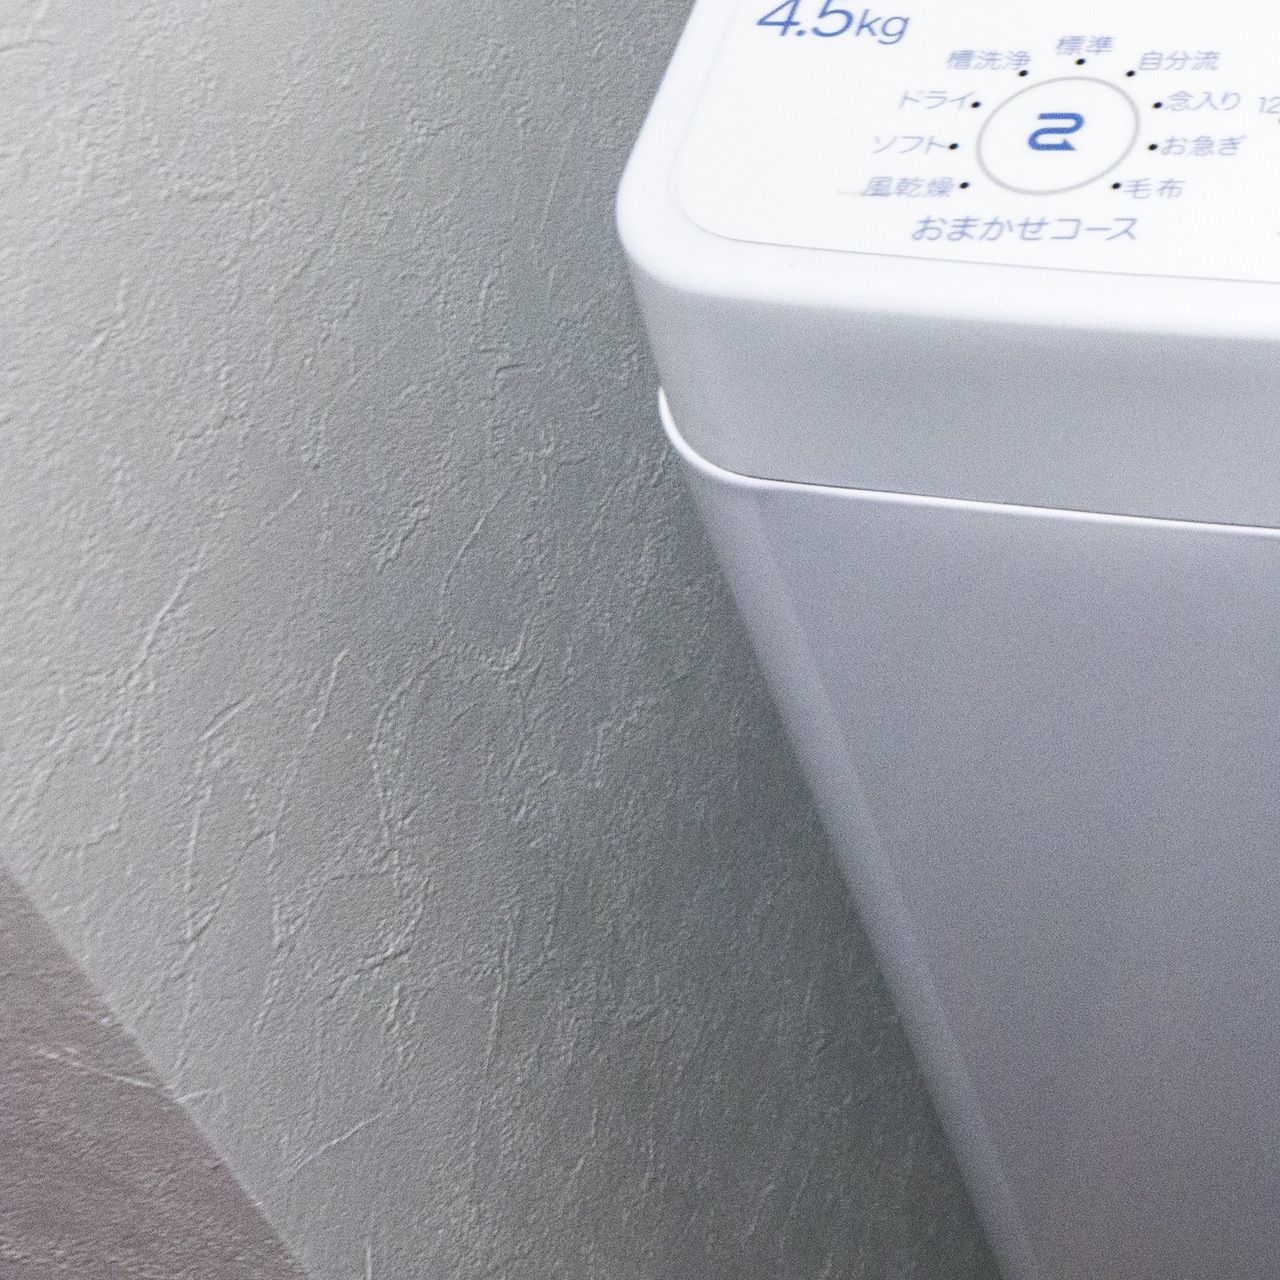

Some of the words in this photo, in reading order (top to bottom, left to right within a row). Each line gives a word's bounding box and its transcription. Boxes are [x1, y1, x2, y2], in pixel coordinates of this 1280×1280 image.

[1055, 34, 1116, 56] 標準
[947, 50, 1031, 72] 槽洗浄
[1139, 51, 1220, 72] 自分流
[898, 90, 969, 111] ドライ
[1166, 90, 1241, 112] 念入り
[873, 135, 947, 156] ソフト
[1161, 136, 1246, 158] お急ぎ
[863, 177, 955, 200] 風乾燥
[1122, 179, 1186, 201] 毛布
[909, 215, 1138, 242] おまかせコース
